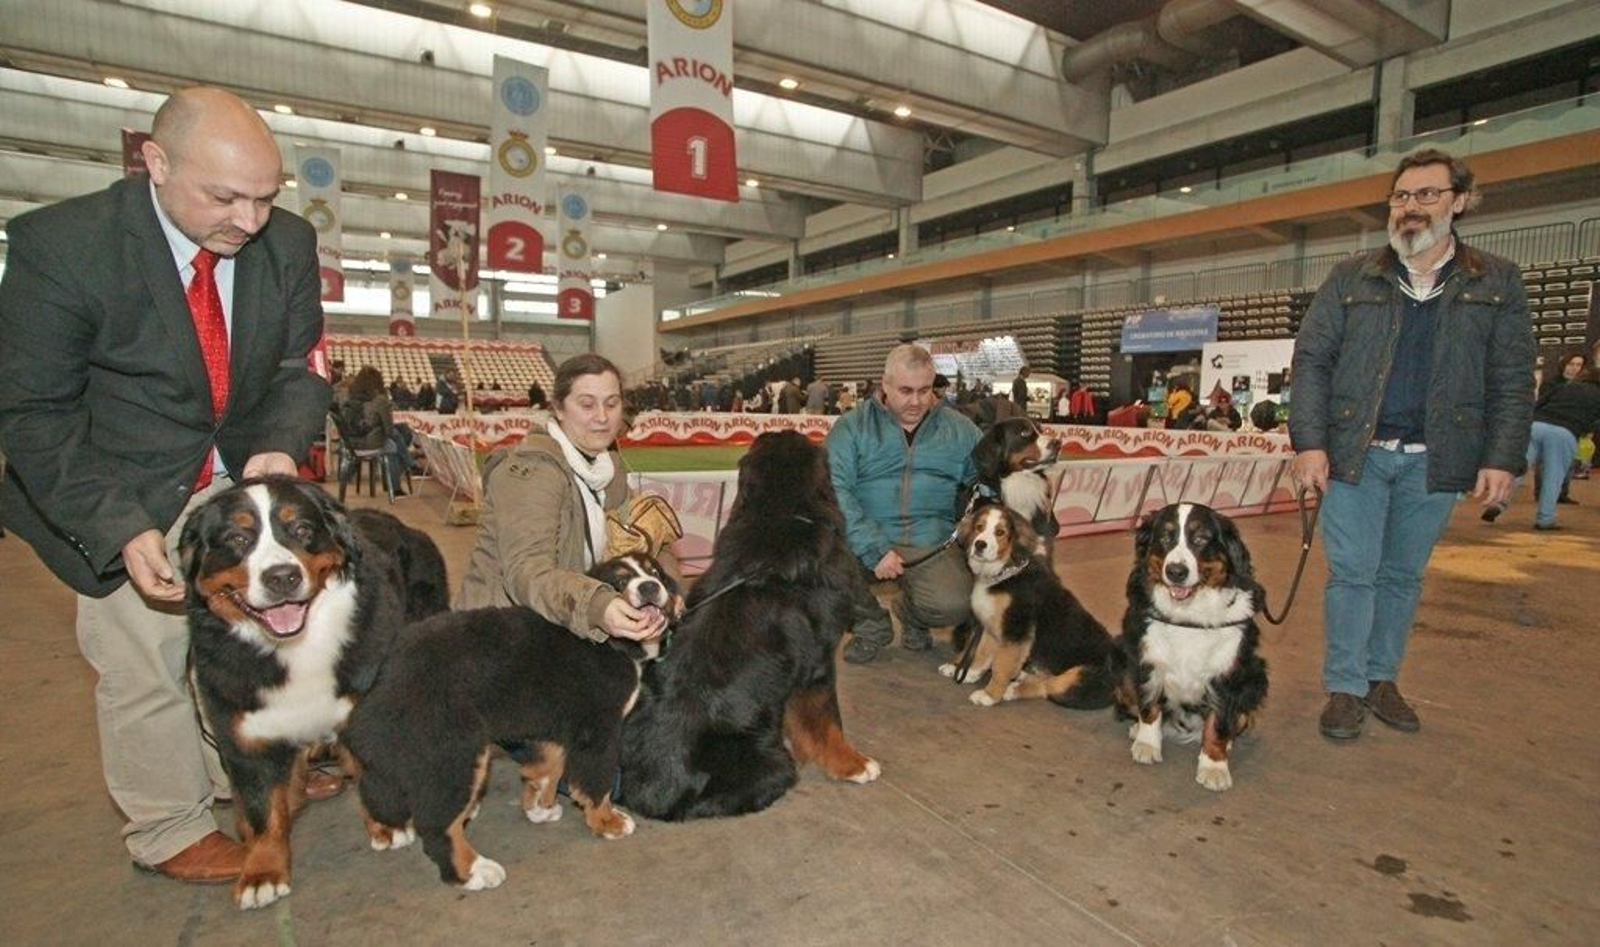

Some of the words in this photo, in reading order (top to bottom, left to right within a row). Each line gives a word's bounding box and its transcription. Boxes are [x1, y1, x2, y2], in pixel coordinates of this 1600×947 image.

[656, 57, 732, 97] ARION
[687, 136, 708, 180] 1
[492, 193, 542, 214] ARION
[505, 237, 525, 261] 2
[569, 298, 581, 314] 3
[494, 417, 531, 434] ARIO
[640, 416, 680, 433] ARION
[683, 416, 721, 433] ARION
[724, 415, 760, 432] ARION
[763, 416, 796, 431] ARION
[799, 416, 830, 431] ARION
[1060, 427, 1092, 442] ARION
[1095, 428, 1131, 444] ARION
[1133, 430, 1174, 448] ARION
[1177, 433, 1222, 451] ARION
[1225, 435, 1277, 453] ARION
